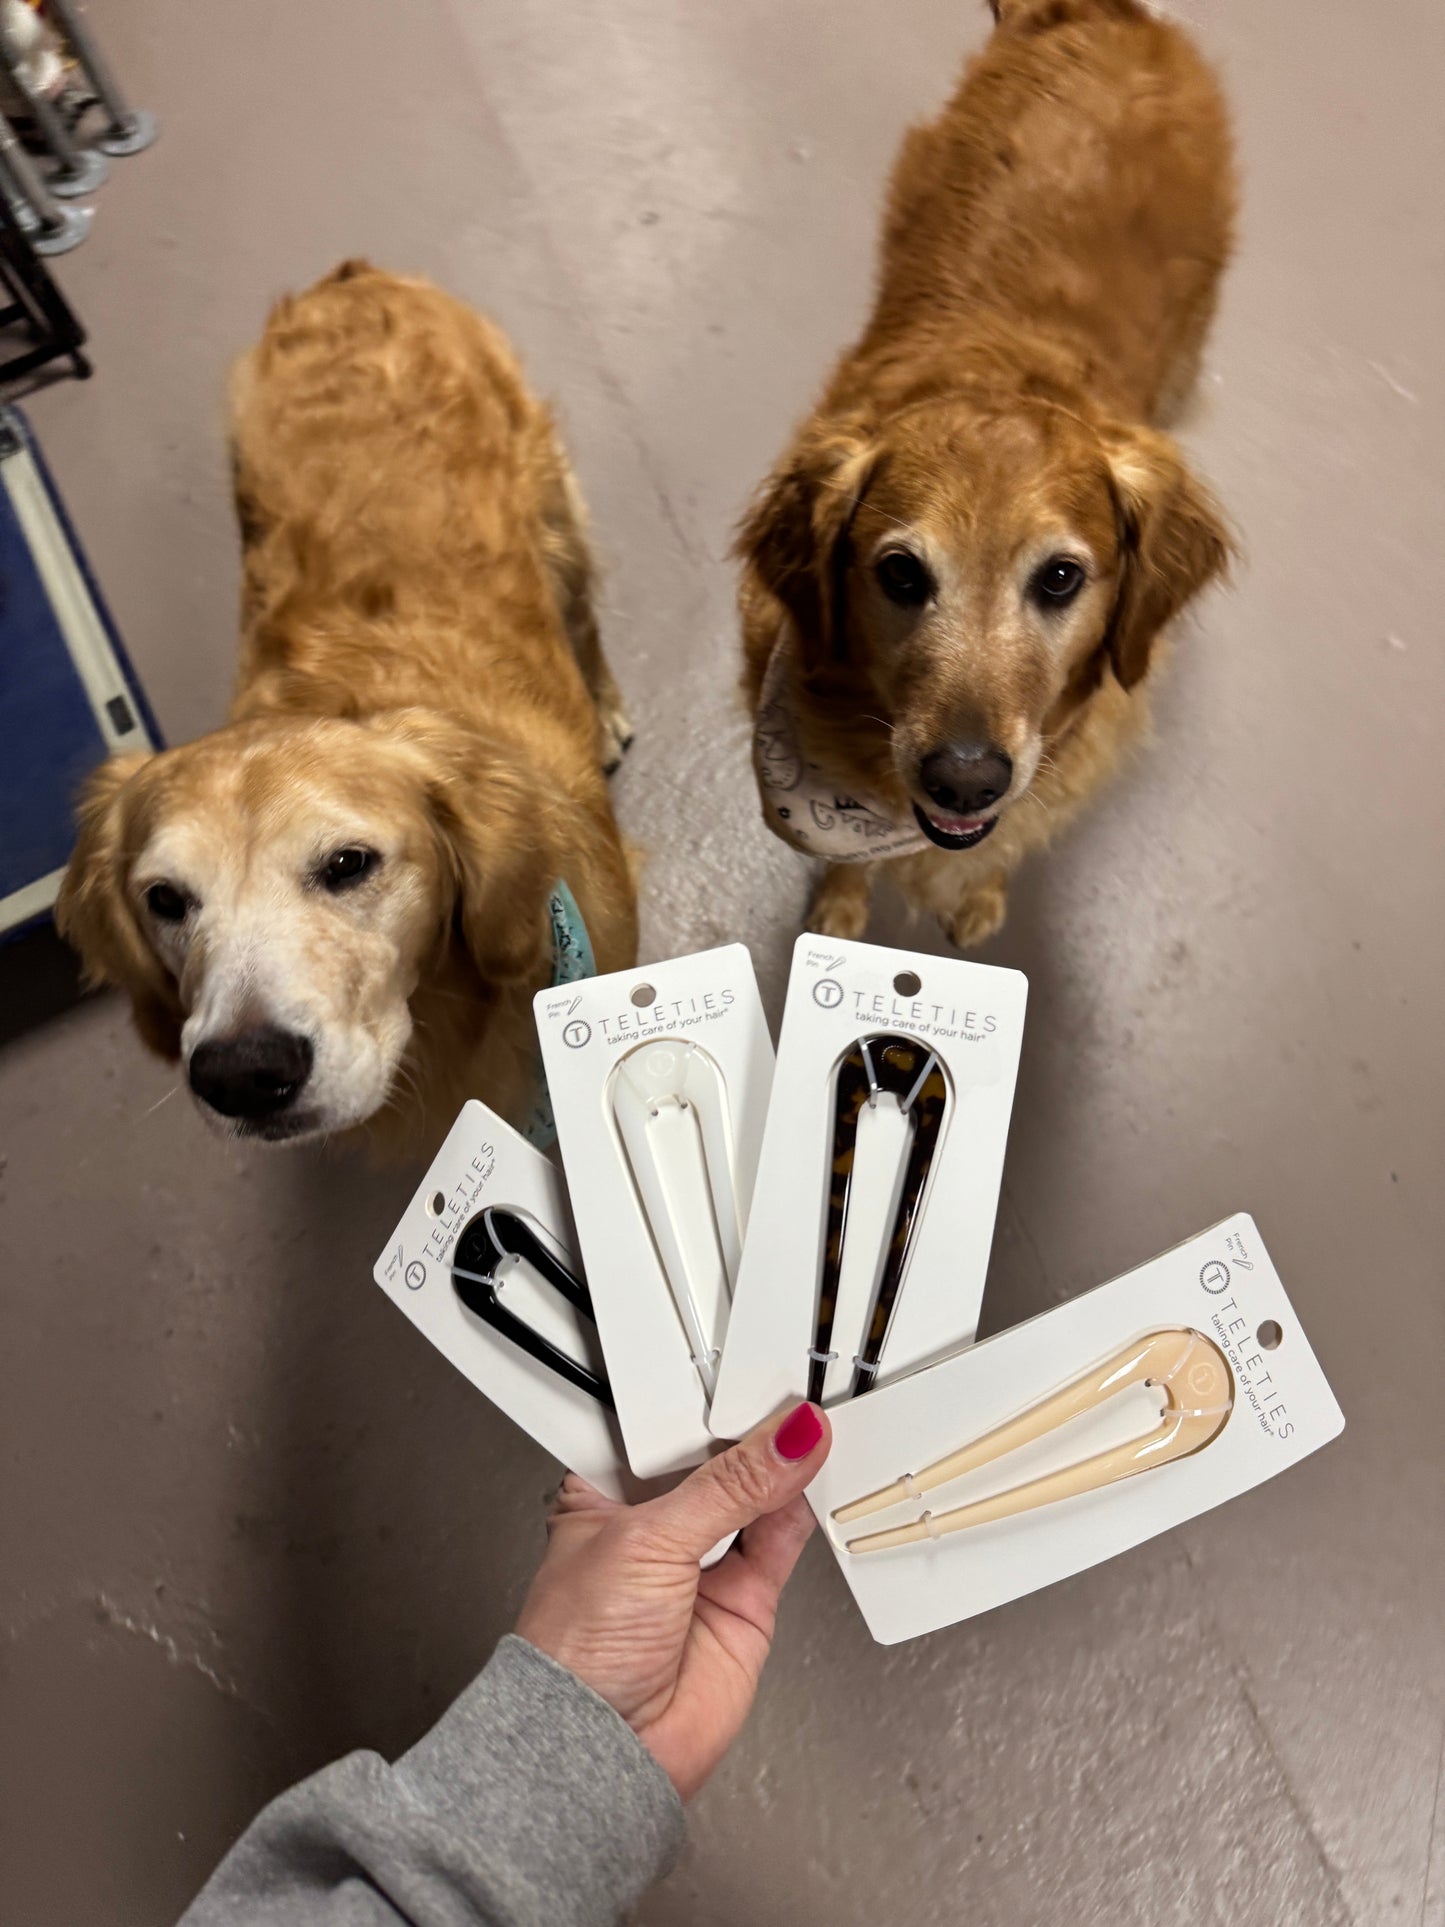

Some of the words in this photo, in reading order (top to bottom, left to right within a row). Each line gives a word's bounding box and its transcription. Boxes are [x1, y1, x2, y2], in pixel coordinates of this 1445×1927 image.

[807, 951, 834, 962] French
[547, 999, 571, 1010] French
[598, 989, 735, 1034] TELETIES
[853, 991, 997, 1033] TELETIES
[607, 1030, 639, 1045] taking
[641, 1025, 664, 1036] care
[666, 1020, 677, 1030] of
[679, 1015, 702, 1029] your
[856, 1011, 889, 1027] taking
[892, 1019, 916, 1030] care
[918, 1022, 930, 1032] of
[933, 1026, 957, 1040] your
[422, 1142, 495, 1258] TELETIES
[436, 1235, 455, 1263] taking
[452, 1215, 466, 1234] care
[463, 1202, 472, 1213] of
[470, 1181, 484, 1203] your
[1225, 1237, 1234, 1251] Pin
[1233, 1232, 1249, 1259] French
[1211, 1313, 1232, 1350] taking
[1221, 1297, 1295, 1440] TELETIES
[1228, 1349, 1243, 1373] care
[1240, 1374, 1252, 1389] of
[1244, 1387, 1262, 1412] your
